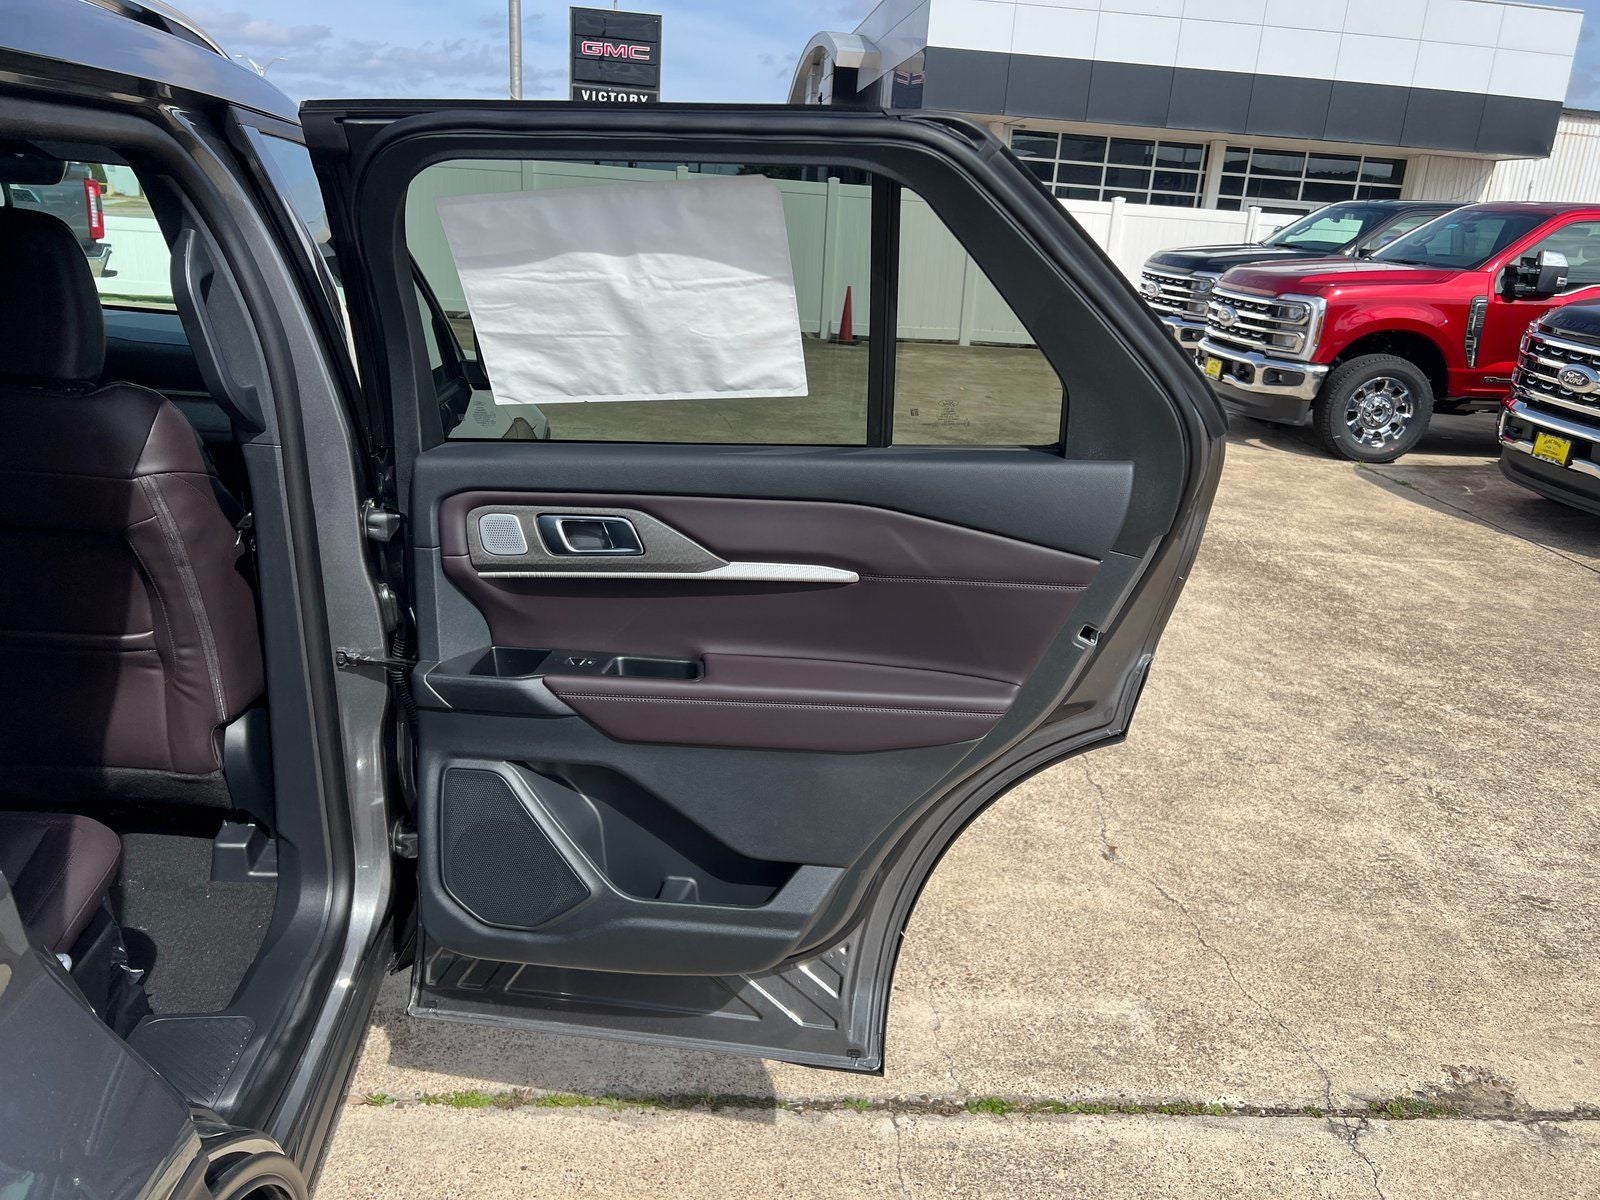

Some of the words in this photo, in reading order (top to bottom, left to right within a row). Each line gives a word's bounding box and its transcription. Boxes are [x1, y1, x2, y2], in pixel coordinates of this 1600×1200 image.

[581, 41, 650, 60] GMC
[581, 90, 649, 102] VICTORY
[1563, 370, 1585, 385] Ford
